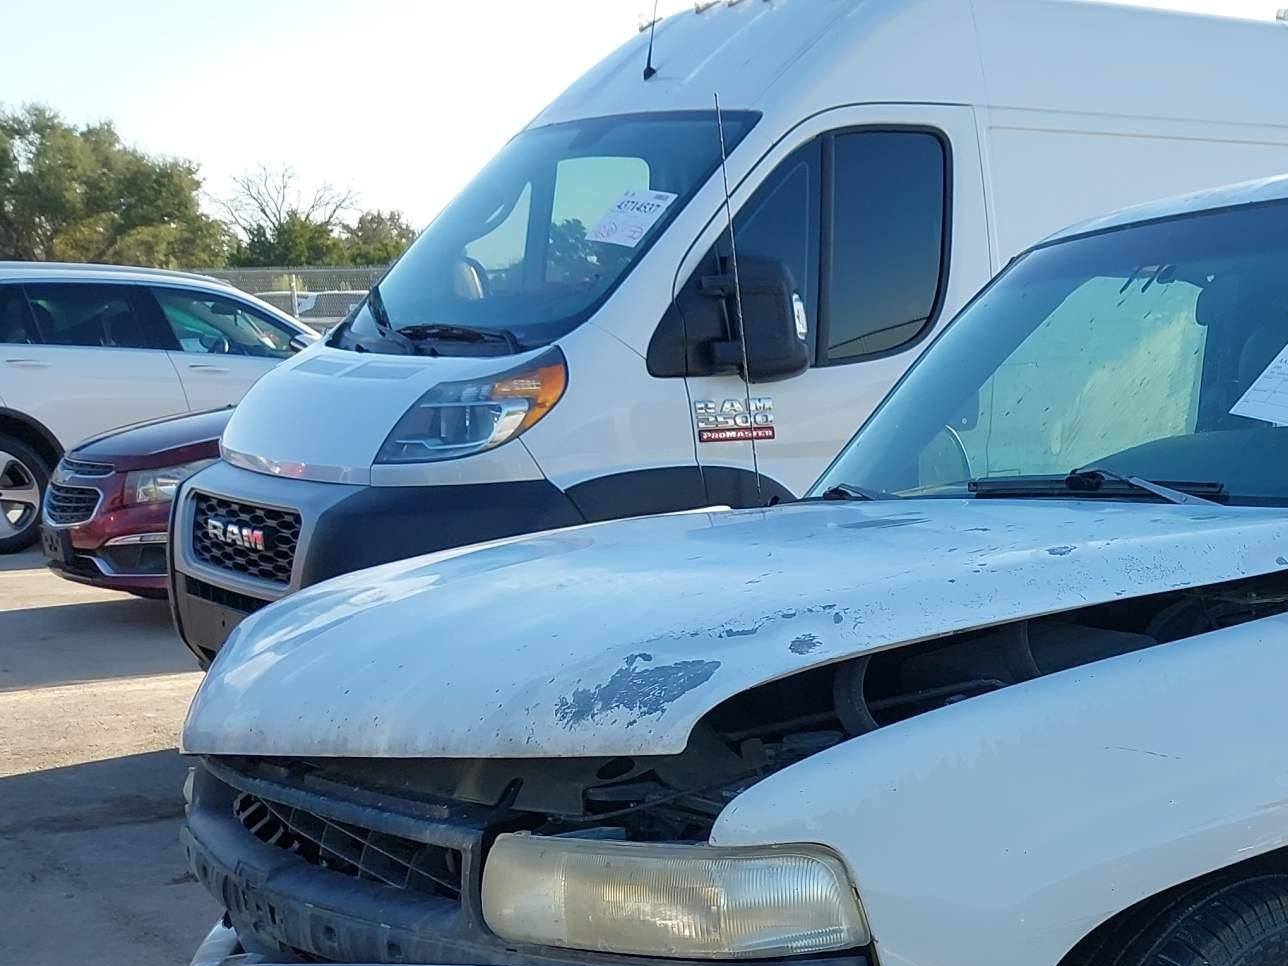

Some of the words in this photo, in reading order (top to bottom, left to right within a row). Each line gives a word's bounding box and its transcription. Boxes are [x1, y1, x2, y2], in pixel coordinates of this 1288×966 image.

[694, 397, 773, 414] RAM
[696, 412, 774, 428] 2500
[207, 518, 265, 551] RAM
